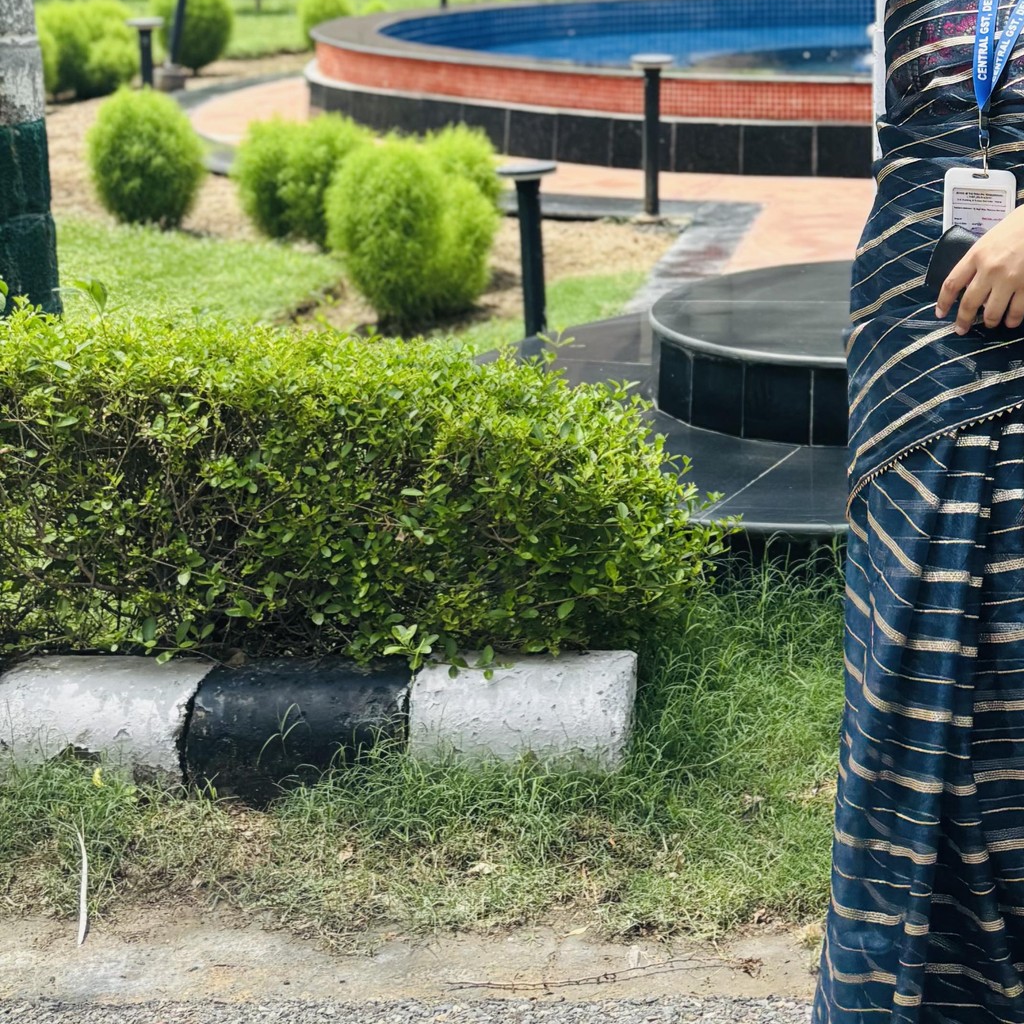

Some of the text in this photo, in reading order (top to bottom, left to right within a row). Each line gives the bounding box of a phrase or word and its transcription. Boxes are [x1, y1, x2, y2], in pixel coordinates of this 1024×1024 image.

[979, 14, 992, 34] GST,
[1005, 17, 1021, 37] GST,
[977, 36, 989, 81] CENTRAL
